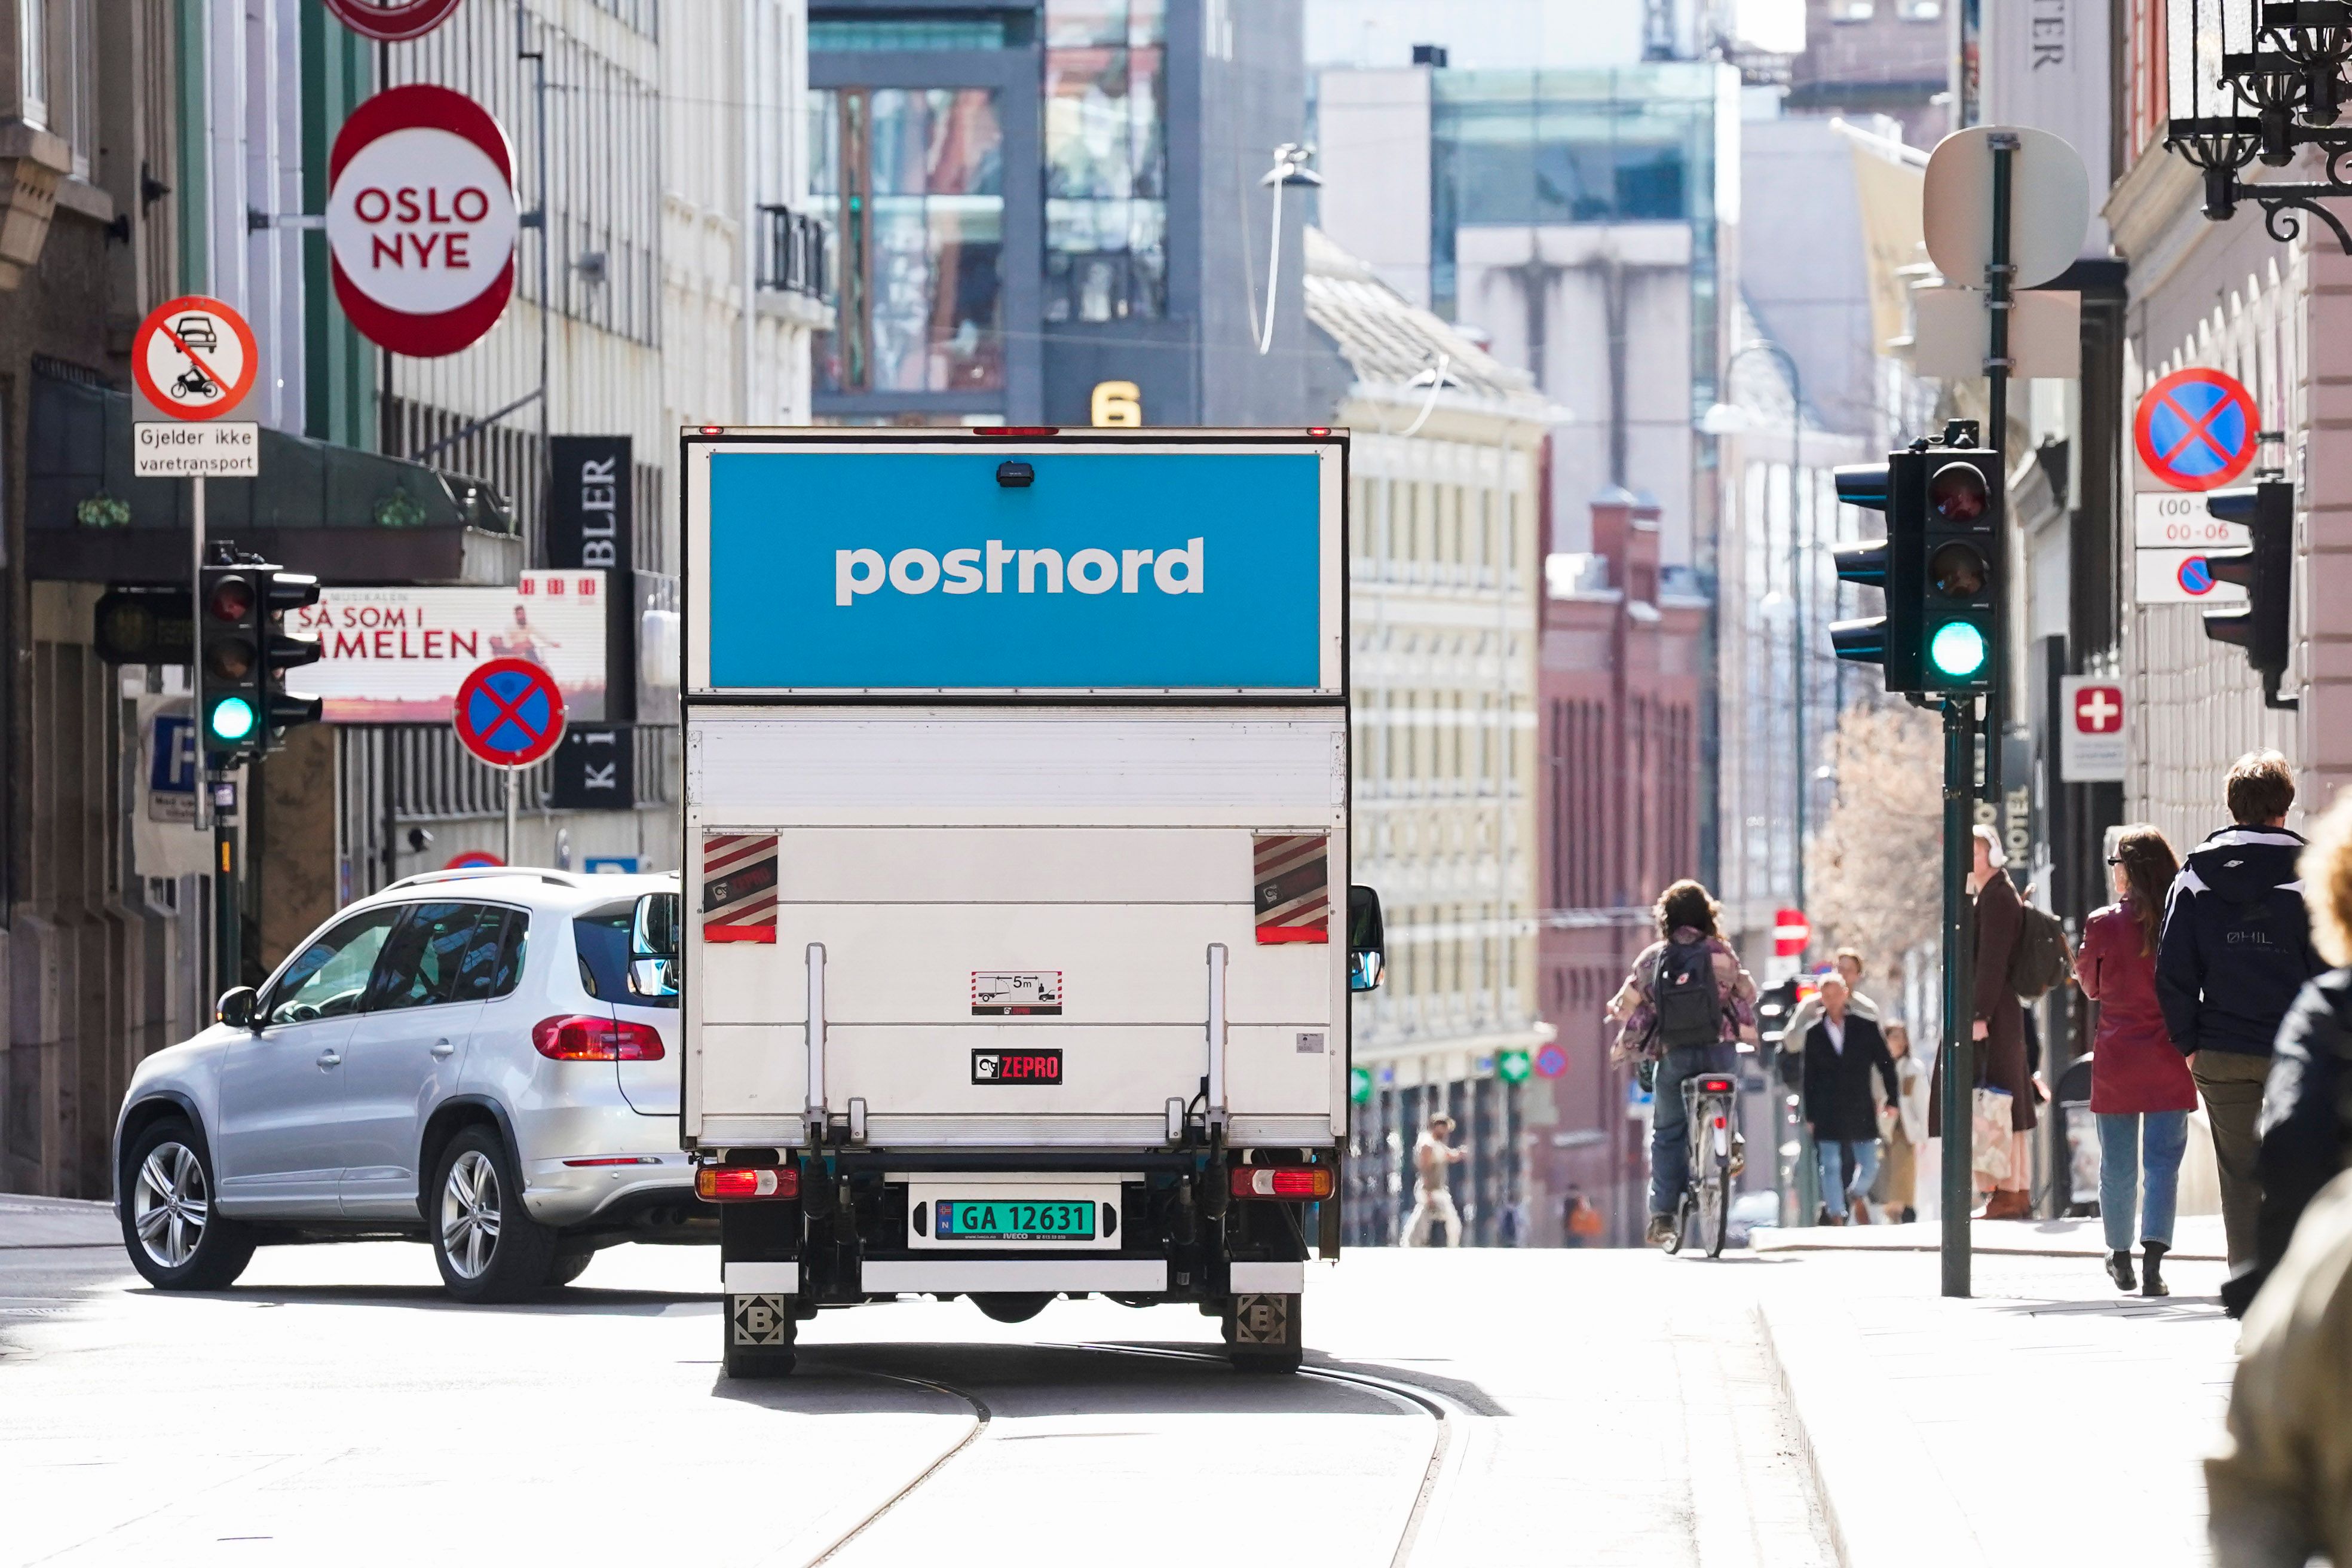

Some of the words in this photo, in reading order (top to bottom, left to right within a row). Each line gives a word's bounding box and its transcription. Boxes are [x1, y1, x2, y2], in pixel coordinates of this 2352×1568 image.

[354, 186, 489, 223] OSLO
[372, 231, 470, 269] NYE
[1091, 380, 1141, 427] 6
[140, 428, 204, 449] Gjelder
[216, 428, 251, 445] ikke
[140, 456, 253, 472] varetransport
[2167, 523, 2229, 540] 00-06
[835, 537, 1204, 606] postnord
[299, 599, 332, 627] SÅ
[343, 606, 406, 627] SOM
[417, 606, 422, 627] I
[2005, 784, 2029, 868] HOTEL
[1013, 976, 1032, 988] 5m
[1002, 1056, 1058, 1078] ZEPRO
[962, 1206, 997, 1230] GA
[1009, 1206, 1083, 1230] 12631
[748, 1306, 774, 1333] B
[1251, 1305, 1276, 1331] B
